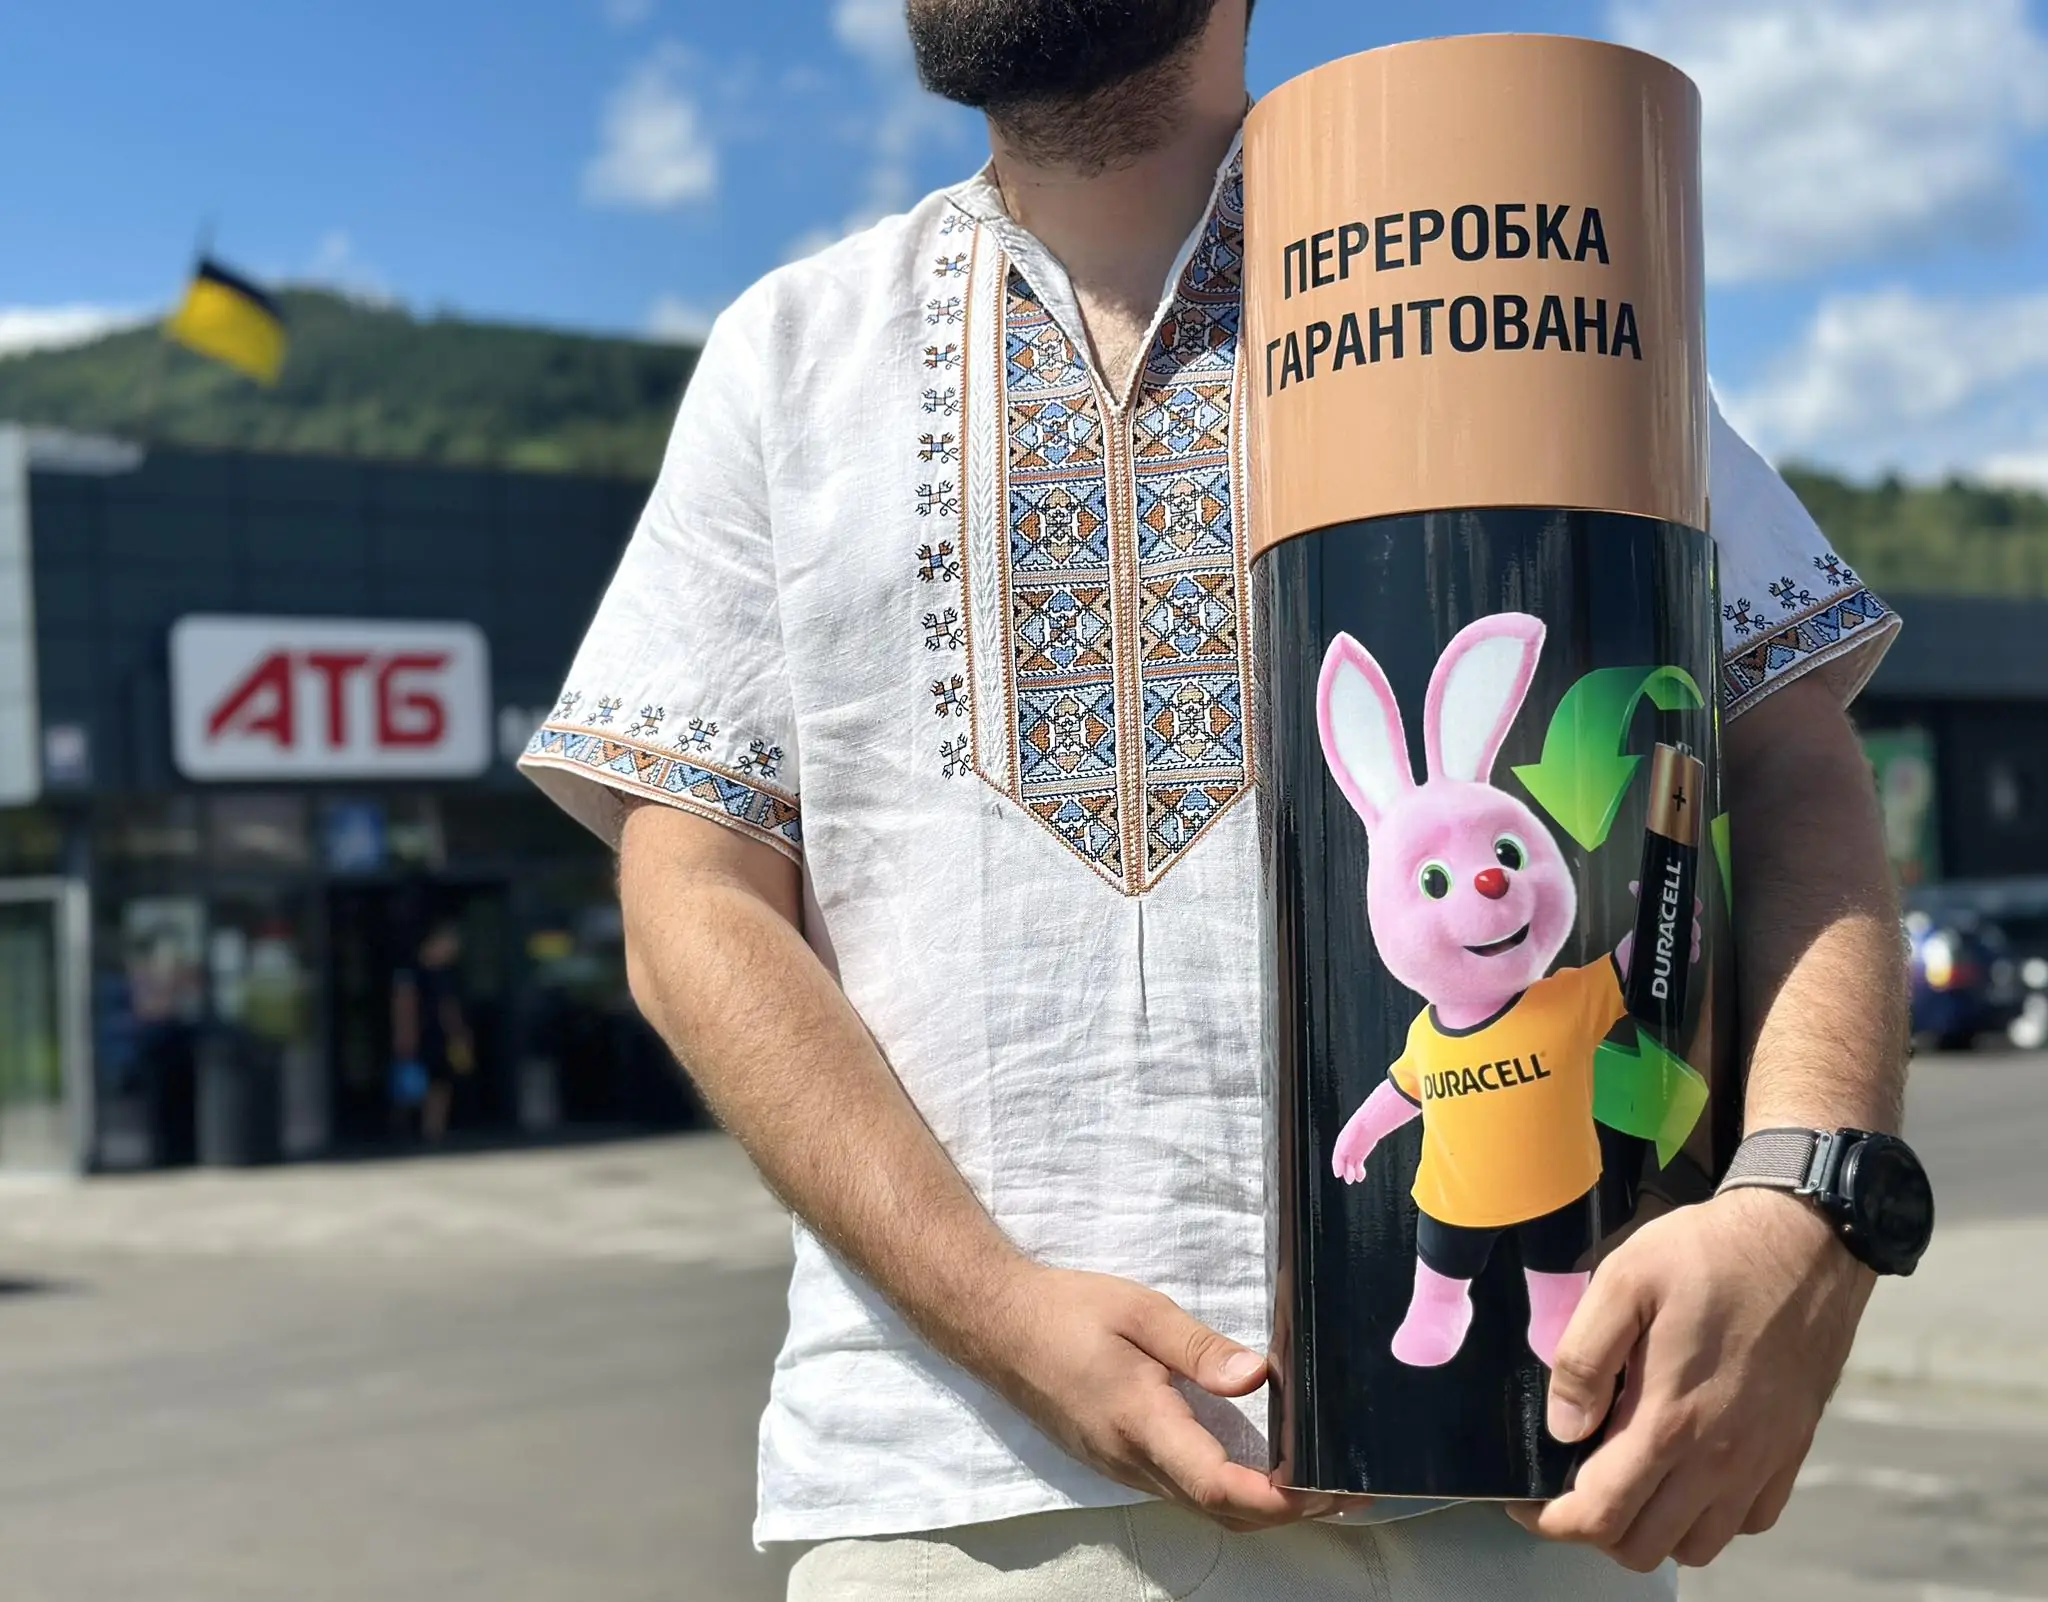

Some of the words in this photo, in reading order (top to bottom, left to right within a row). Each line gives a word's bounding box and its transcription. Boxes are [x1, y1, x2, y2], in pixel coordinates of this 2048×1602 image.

[1284, 203, 1610, 300] ПЕРЕРОБКА
[1266, 294, 1643, 397] ГАРАНТОВАНА
[205, 650, 452, 752] АТБ
[1651, 860, 1682, 1000] DURACELL
[1424, 1053, 1551, 1100] DURACELL
